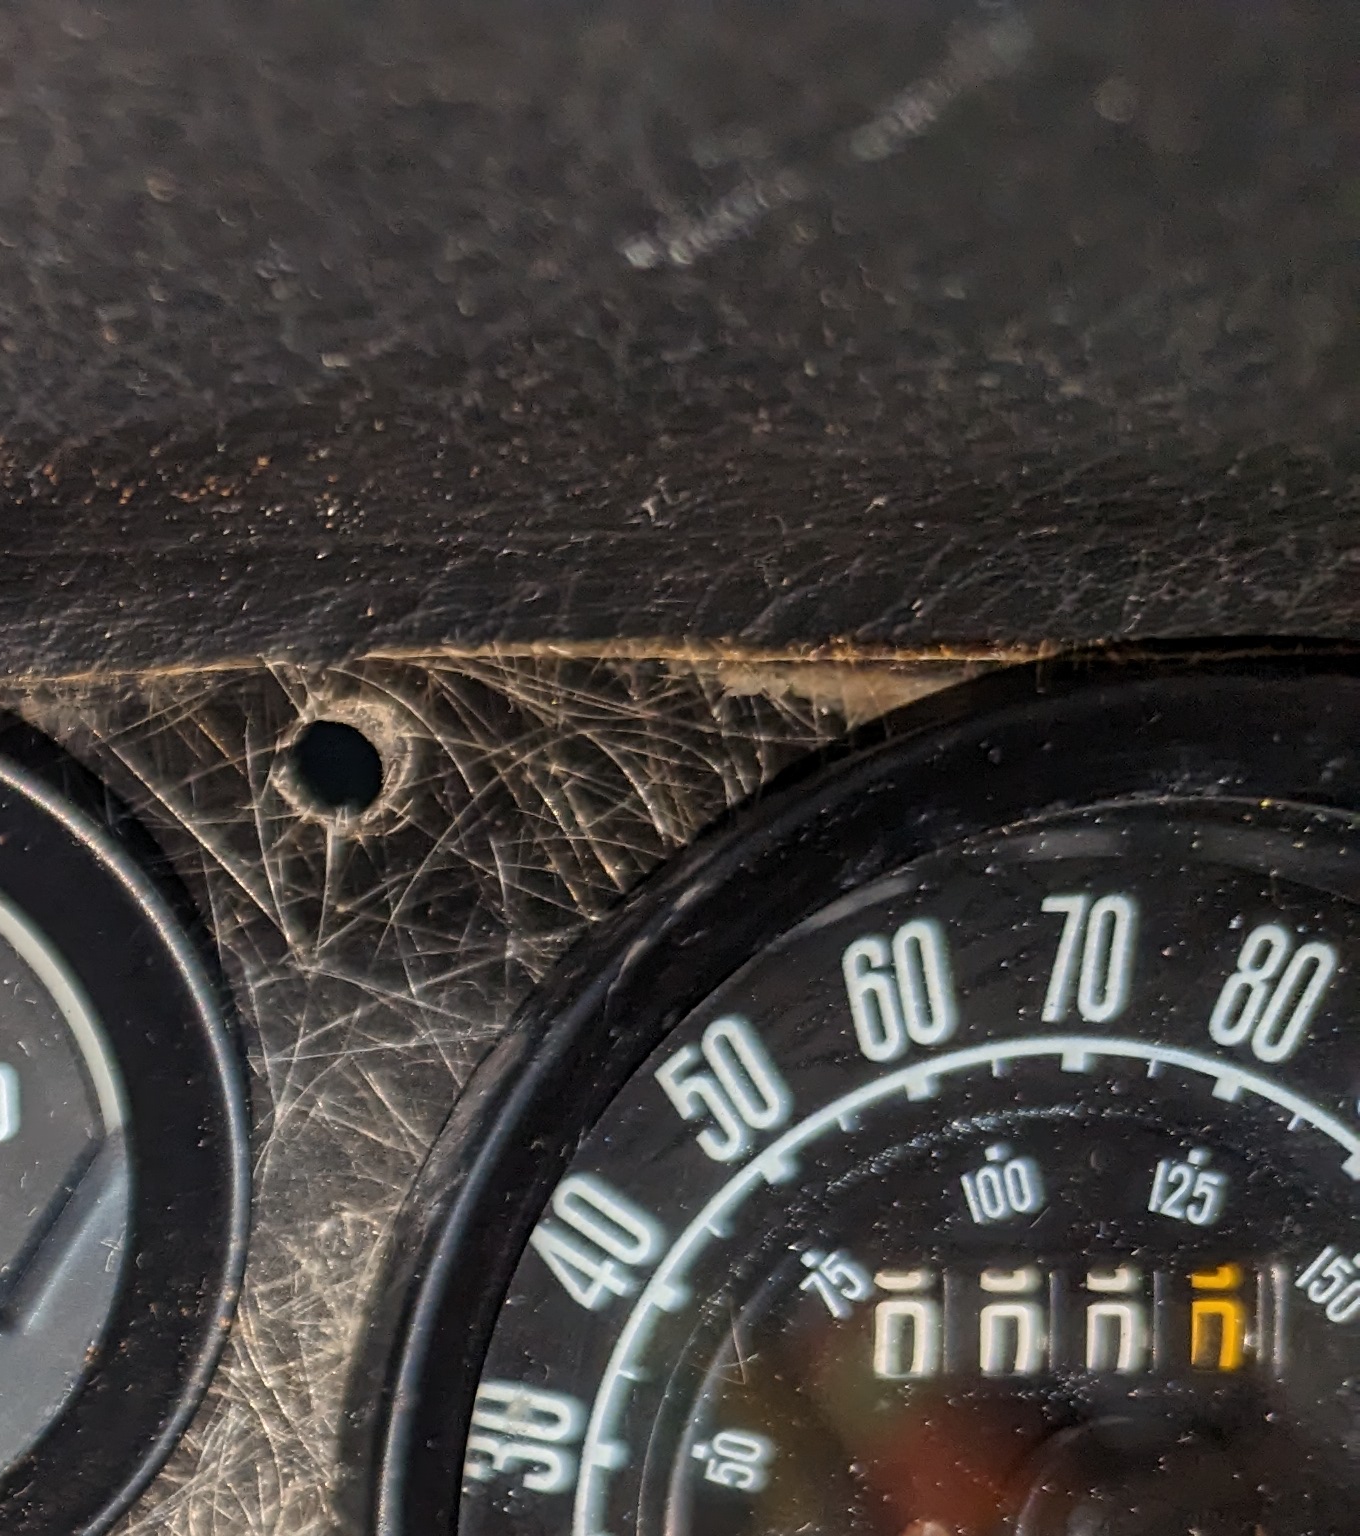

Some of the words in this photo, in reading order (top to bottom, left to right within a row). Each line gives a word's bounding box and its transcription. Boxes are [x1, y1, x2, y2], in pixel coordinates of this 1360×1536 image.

[465, 1383, 580, 1490] 30
[529, 1173, 661, 1311] 40
[654, 1015, 791, 1164] 50
[841, 919, 955, 1061] 60
[1041, 893, 1137, 1023] 70
[1209, 924, 1337, 1061] 80
[704, 1430, 770, 1492] 50
[799, 1248, 872, 1317] 75
[960, 1160, 1041, 1225] 100
[1149, 1160, 1226, 1226] 125
[1294, 1246, 1360, 1323] 150
